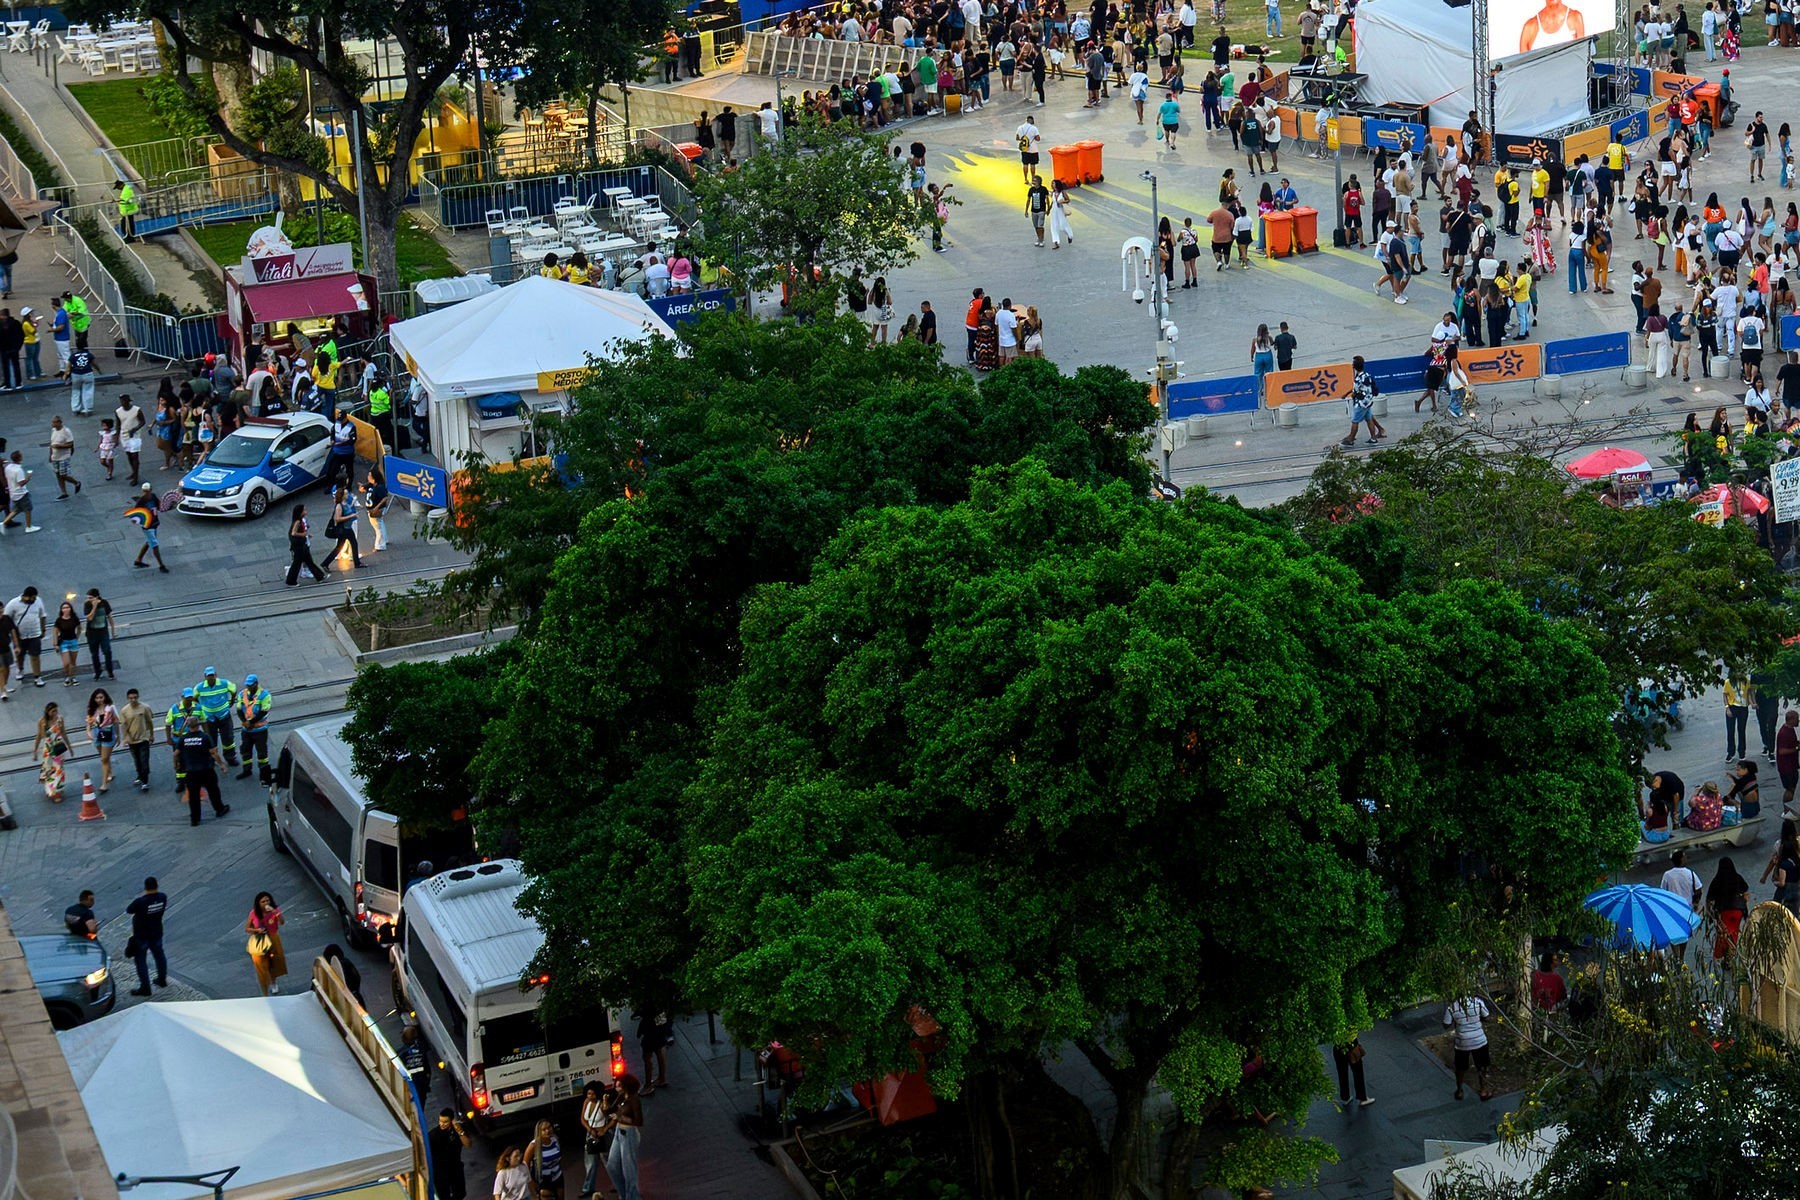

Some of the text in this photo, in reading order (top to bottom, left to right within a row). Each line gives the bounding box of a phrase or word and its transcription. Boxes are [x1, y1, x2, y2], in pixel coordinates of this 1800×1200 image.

[260, 260, 292, 281] Vitali
[554, 371, 583, 380] POSTO
[554, 1076, 565, 1084] RJ
